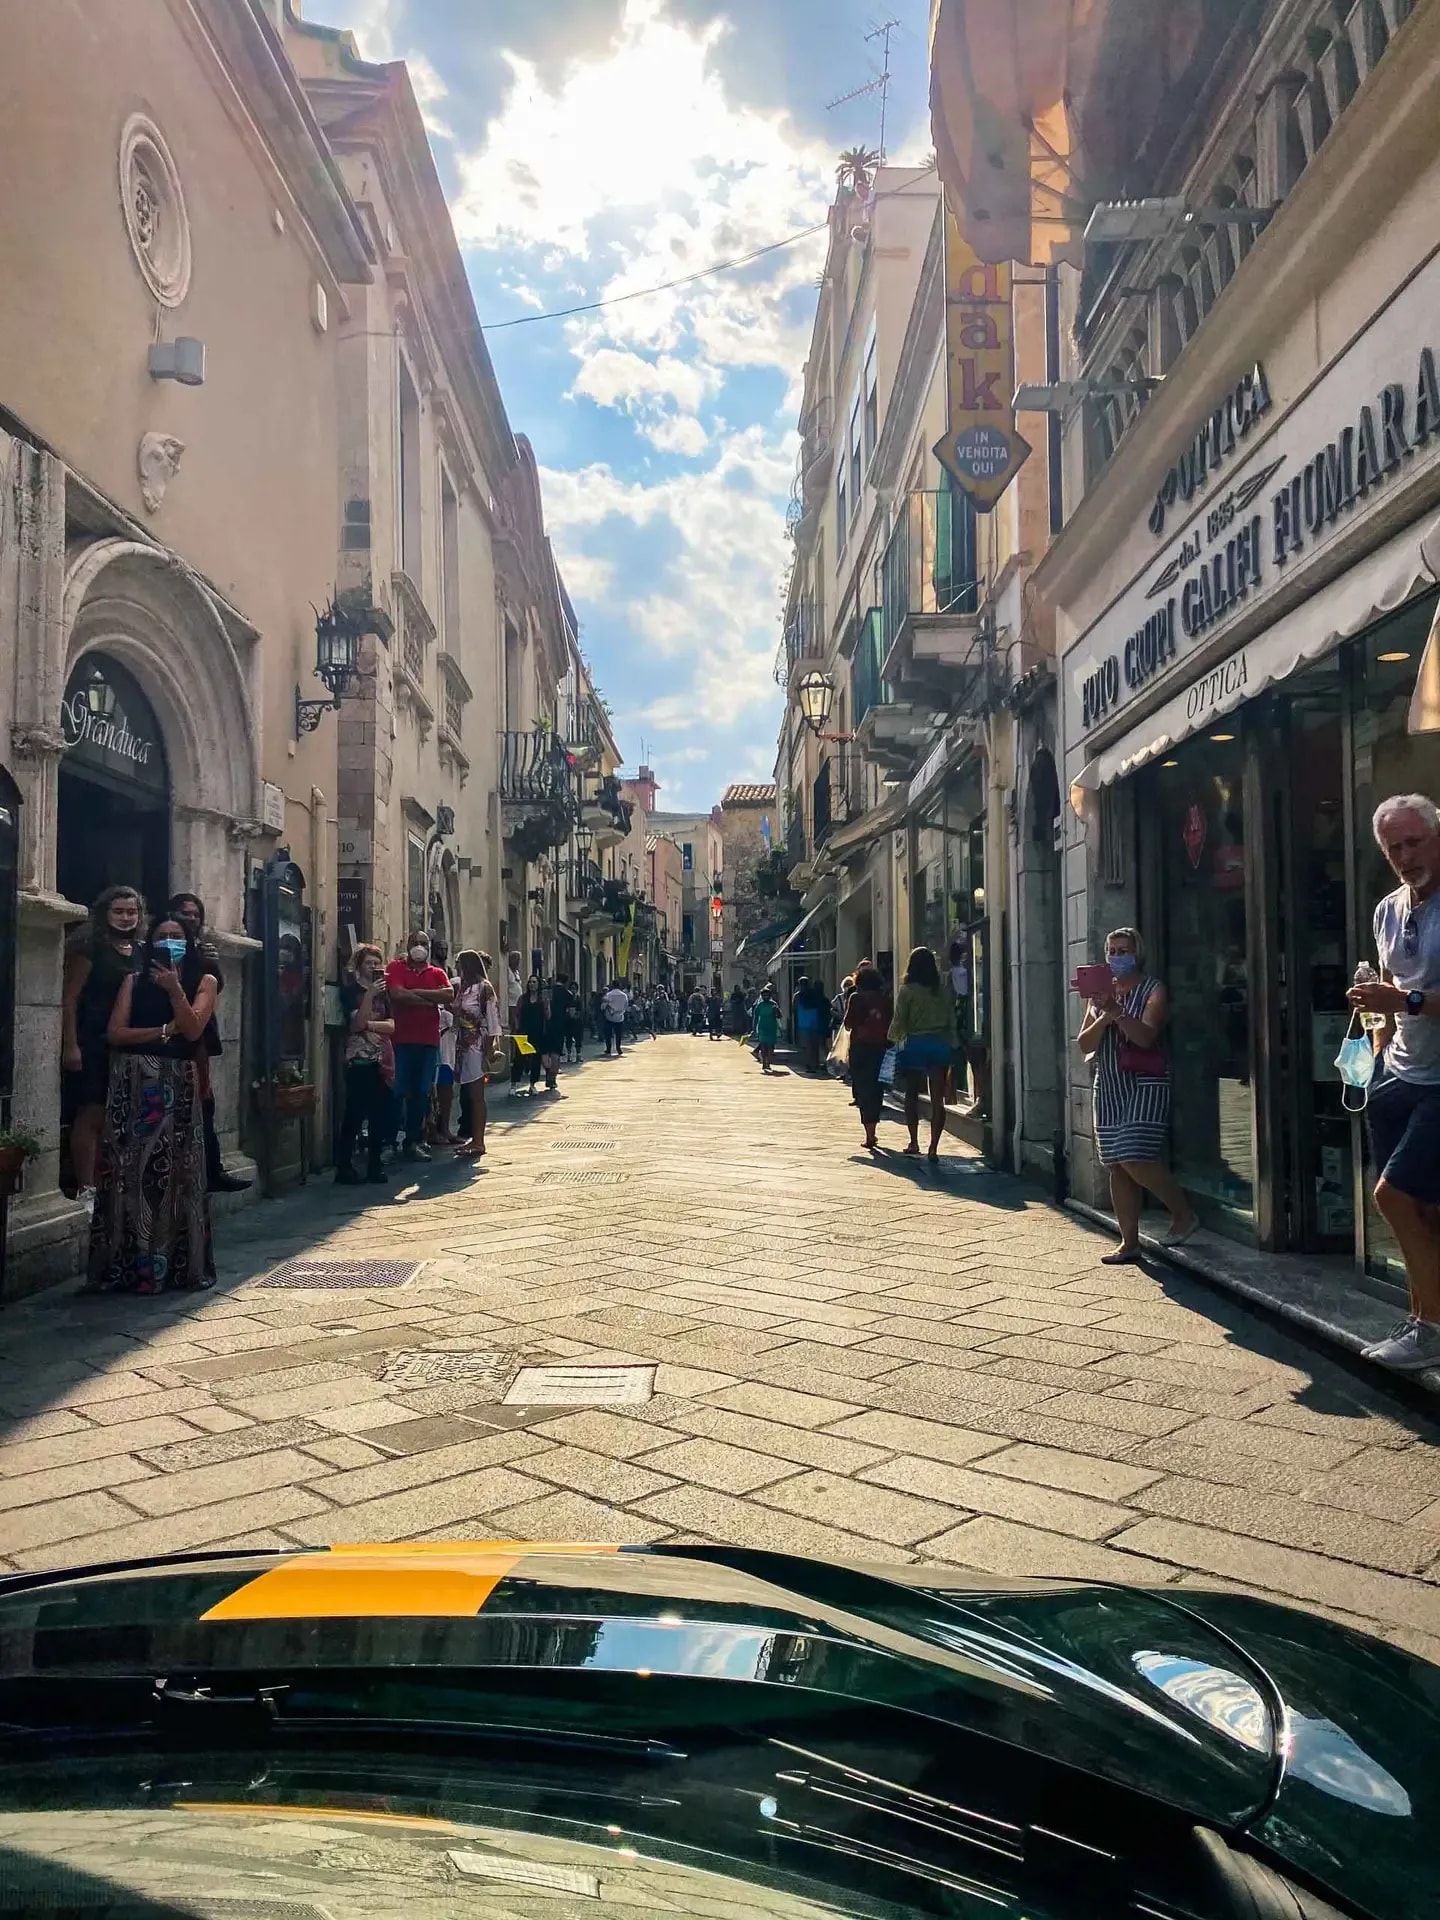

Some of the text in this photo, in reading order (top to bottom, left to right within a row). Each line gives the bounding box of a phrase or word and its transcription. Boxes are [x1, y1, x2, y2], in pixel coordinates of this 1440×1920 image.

[957, 445, 1008, 459] VENDITA
[974, 431, 989, 443] IN
[972, 461, 994, 475] QUI
[1124, 598, 1177, 688] CRUPI
[1270, 347, 1440, 565] FIUMARA
[1179, 530, 1201, 570] dal
[1187, 651, 1248, 719] OTTICA
[62, 691, 152, 764] Granduca
